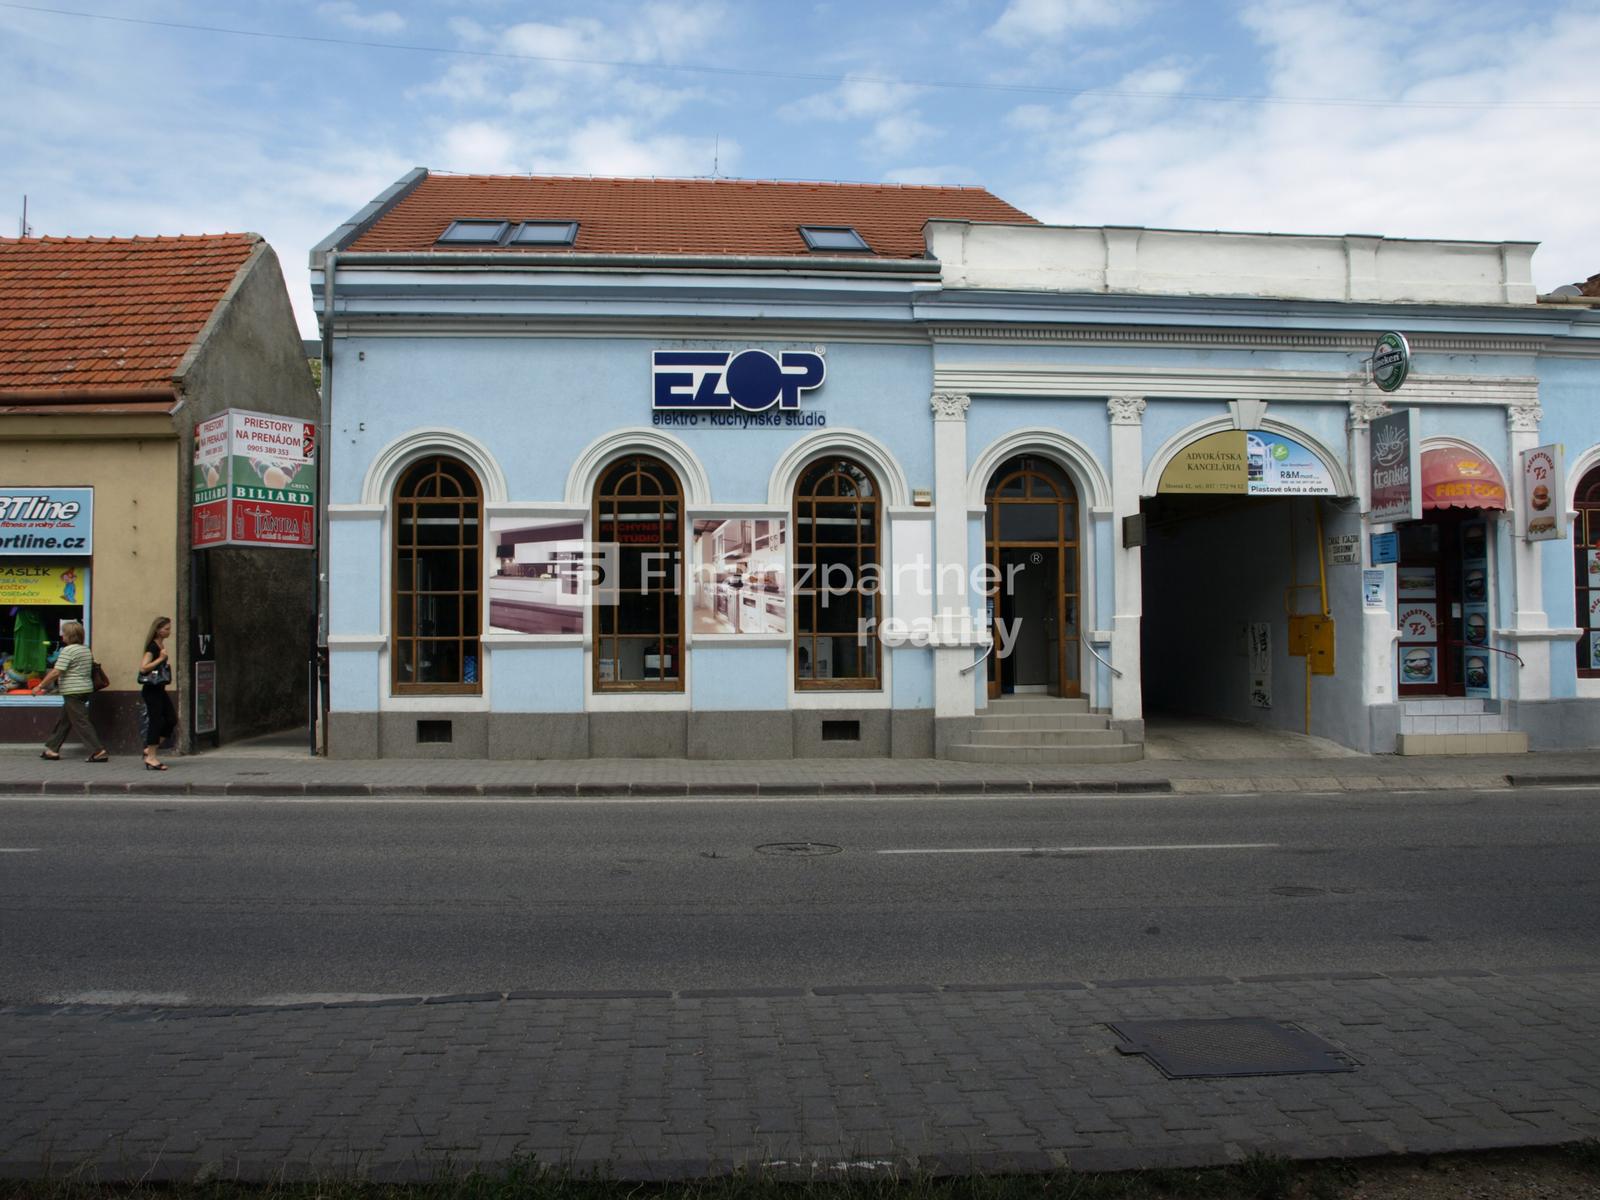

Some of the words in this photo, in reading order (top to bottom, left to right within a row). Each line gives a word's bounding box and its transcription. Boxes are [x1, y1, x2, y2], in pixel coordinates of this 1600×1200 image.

[652, 349, 827, 412] EZOP
[244, 417, 293, 433] PRIESTORY
[652, 411, 698, 426] elektro
[710, 410, 781, 429] kuchynské
[785, 411, 826, 426] štúdio
[236, 430, 249, 440] NA
[251, 431, 301, 447] PRENÁJOM
[247, 444, 263, 453] 0905
[277, 448, 289, 456] 353
[1186, 451, 1242, 461] ADVOKÁTSKA
[1187, 462, 1241, 471] KANCELÁRIA
[1280, 471, 1300, 479] R&M
[1373, 464, 1409, 488] frankie
[195, 486, 227, 503] BILIARD
[236, 486, 310, 503] BILIARD
[1284, 485, 1301, 493] okná
[1309, 485, 1329, 493] dvere
[1435, 483, 1472, 497] FAST
